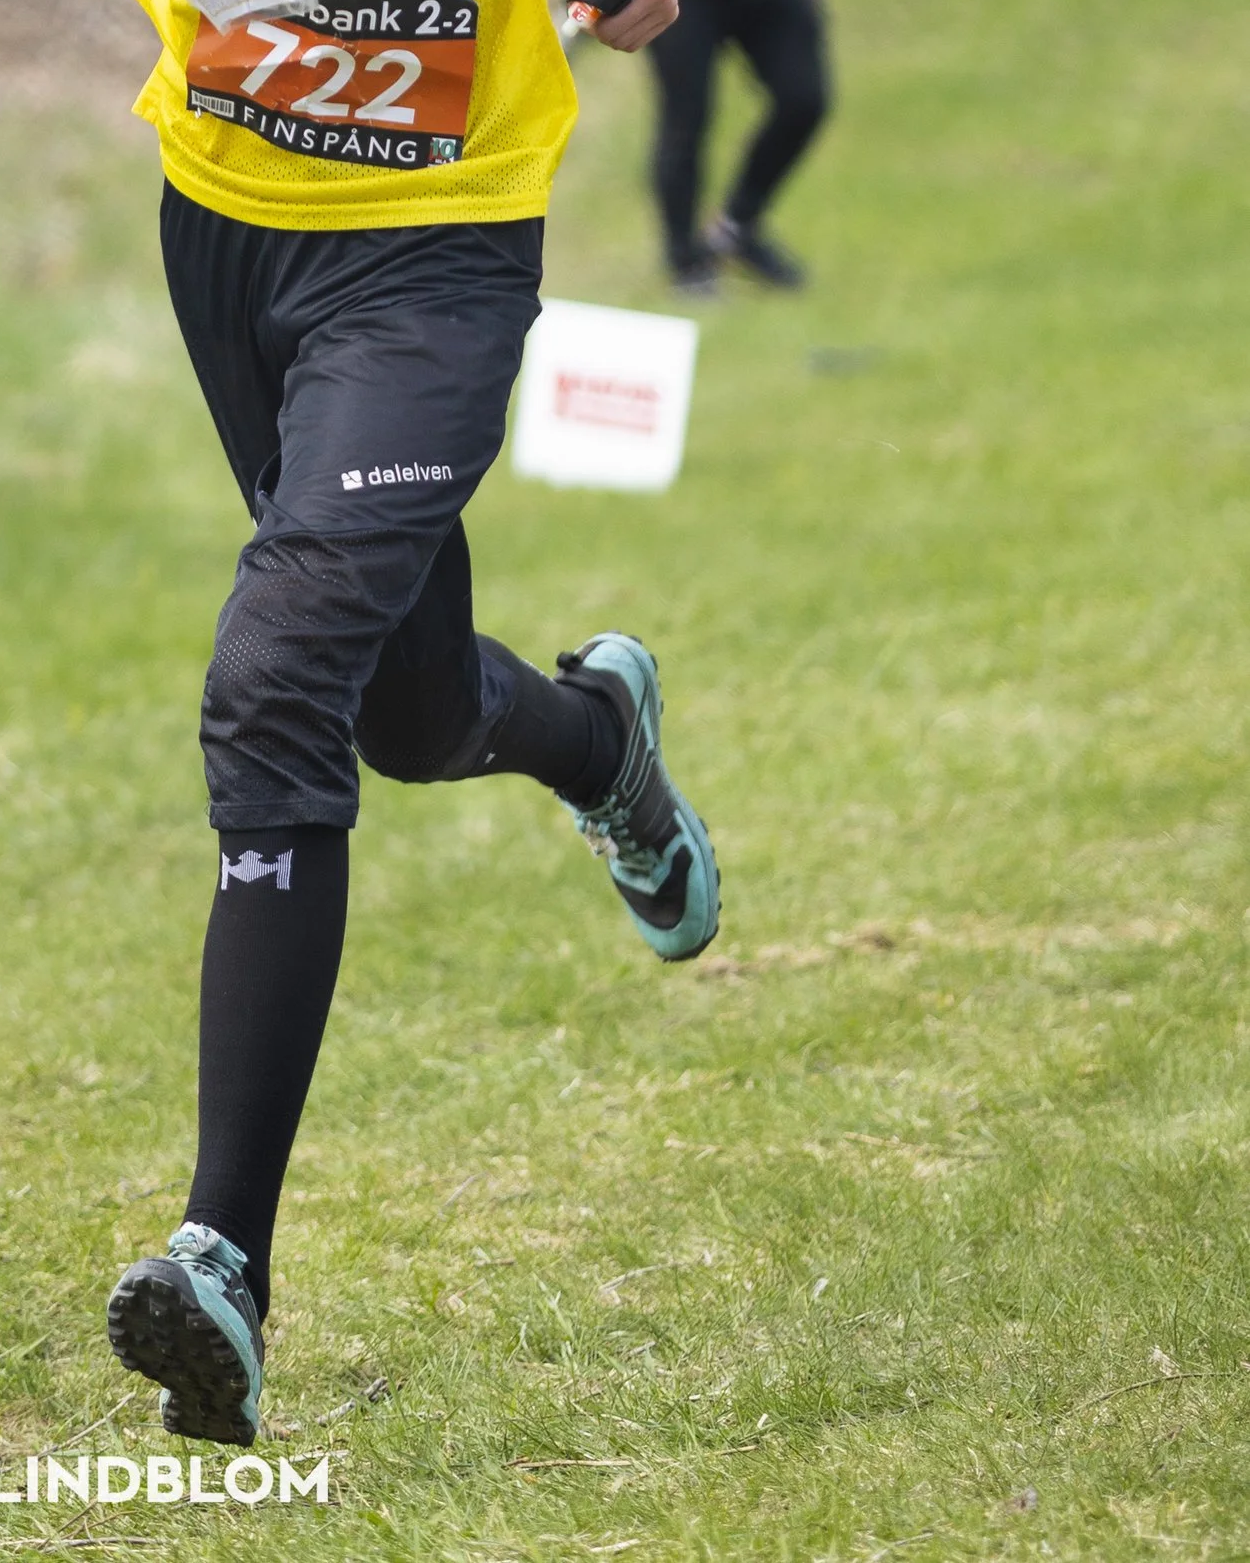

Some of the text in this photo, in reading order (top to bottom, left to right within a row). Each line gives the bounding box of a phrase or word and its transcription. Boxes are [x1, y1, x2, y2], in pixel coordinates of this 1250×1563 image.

[415, 0, 472, 35] 2-2
[240, 21, 422, 125] 722
[243, 105, 418, 163] FINSPÅNG
[368, 461, 453, 486] dalelven
